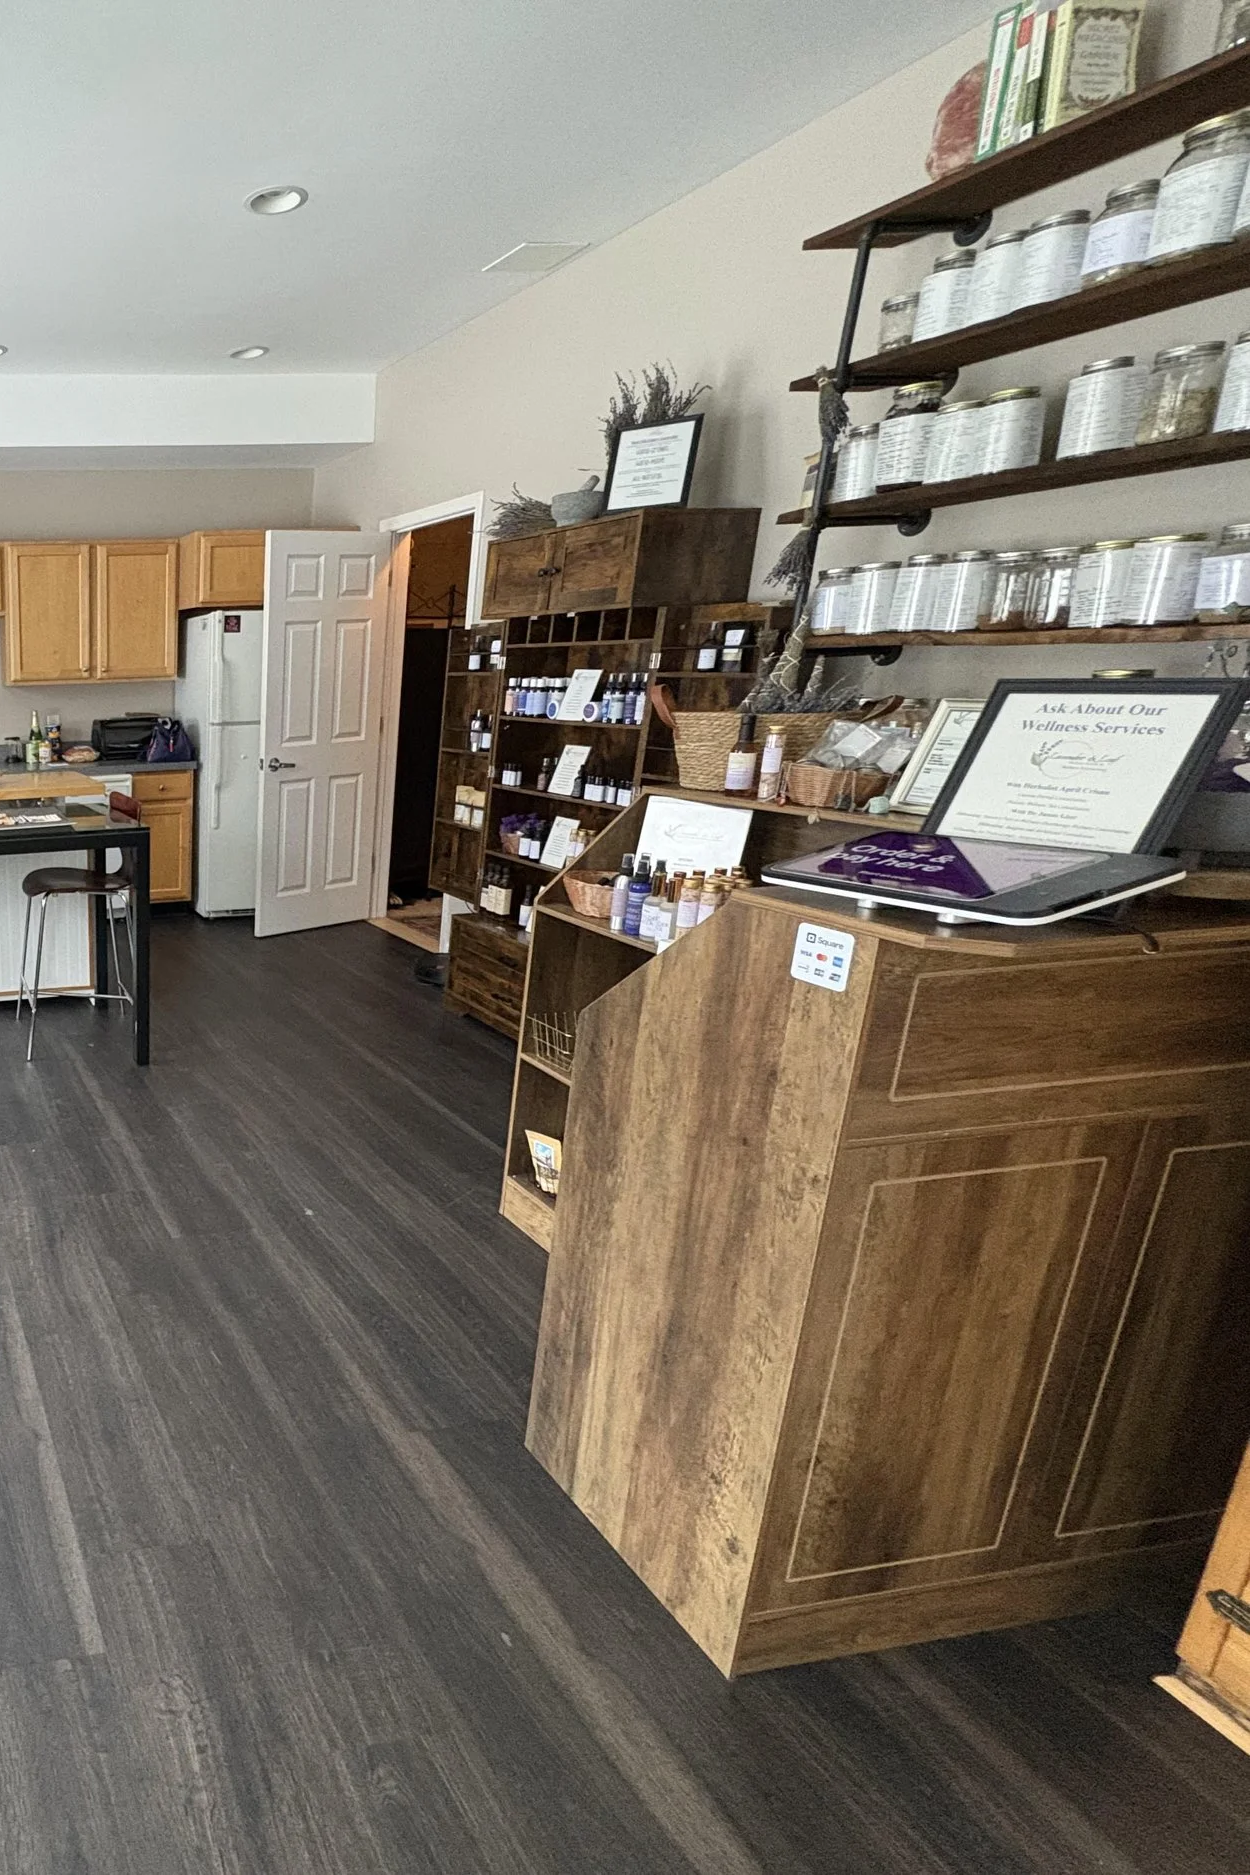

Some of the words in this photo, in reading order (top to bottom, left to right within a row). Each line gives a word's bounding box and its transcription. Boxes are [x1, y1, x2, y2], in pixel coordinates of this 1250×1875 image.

[1035, 703, 1068, 714] Ask
[1070, 703, 1125, 715] About
[1129, 704, 1168, 716] Our
[1022, 720, 1089, 732] Wellness
[1092, 722, 1167, 735] Services
[1059, 786, 1081, 794] April
[851, 845, 931, 860] Order
[929, 854, 956, 864] &
[824, 852, 880, 864] pay
[875, 857, 945, 872] here
[817, 937, 844, 950] Square
